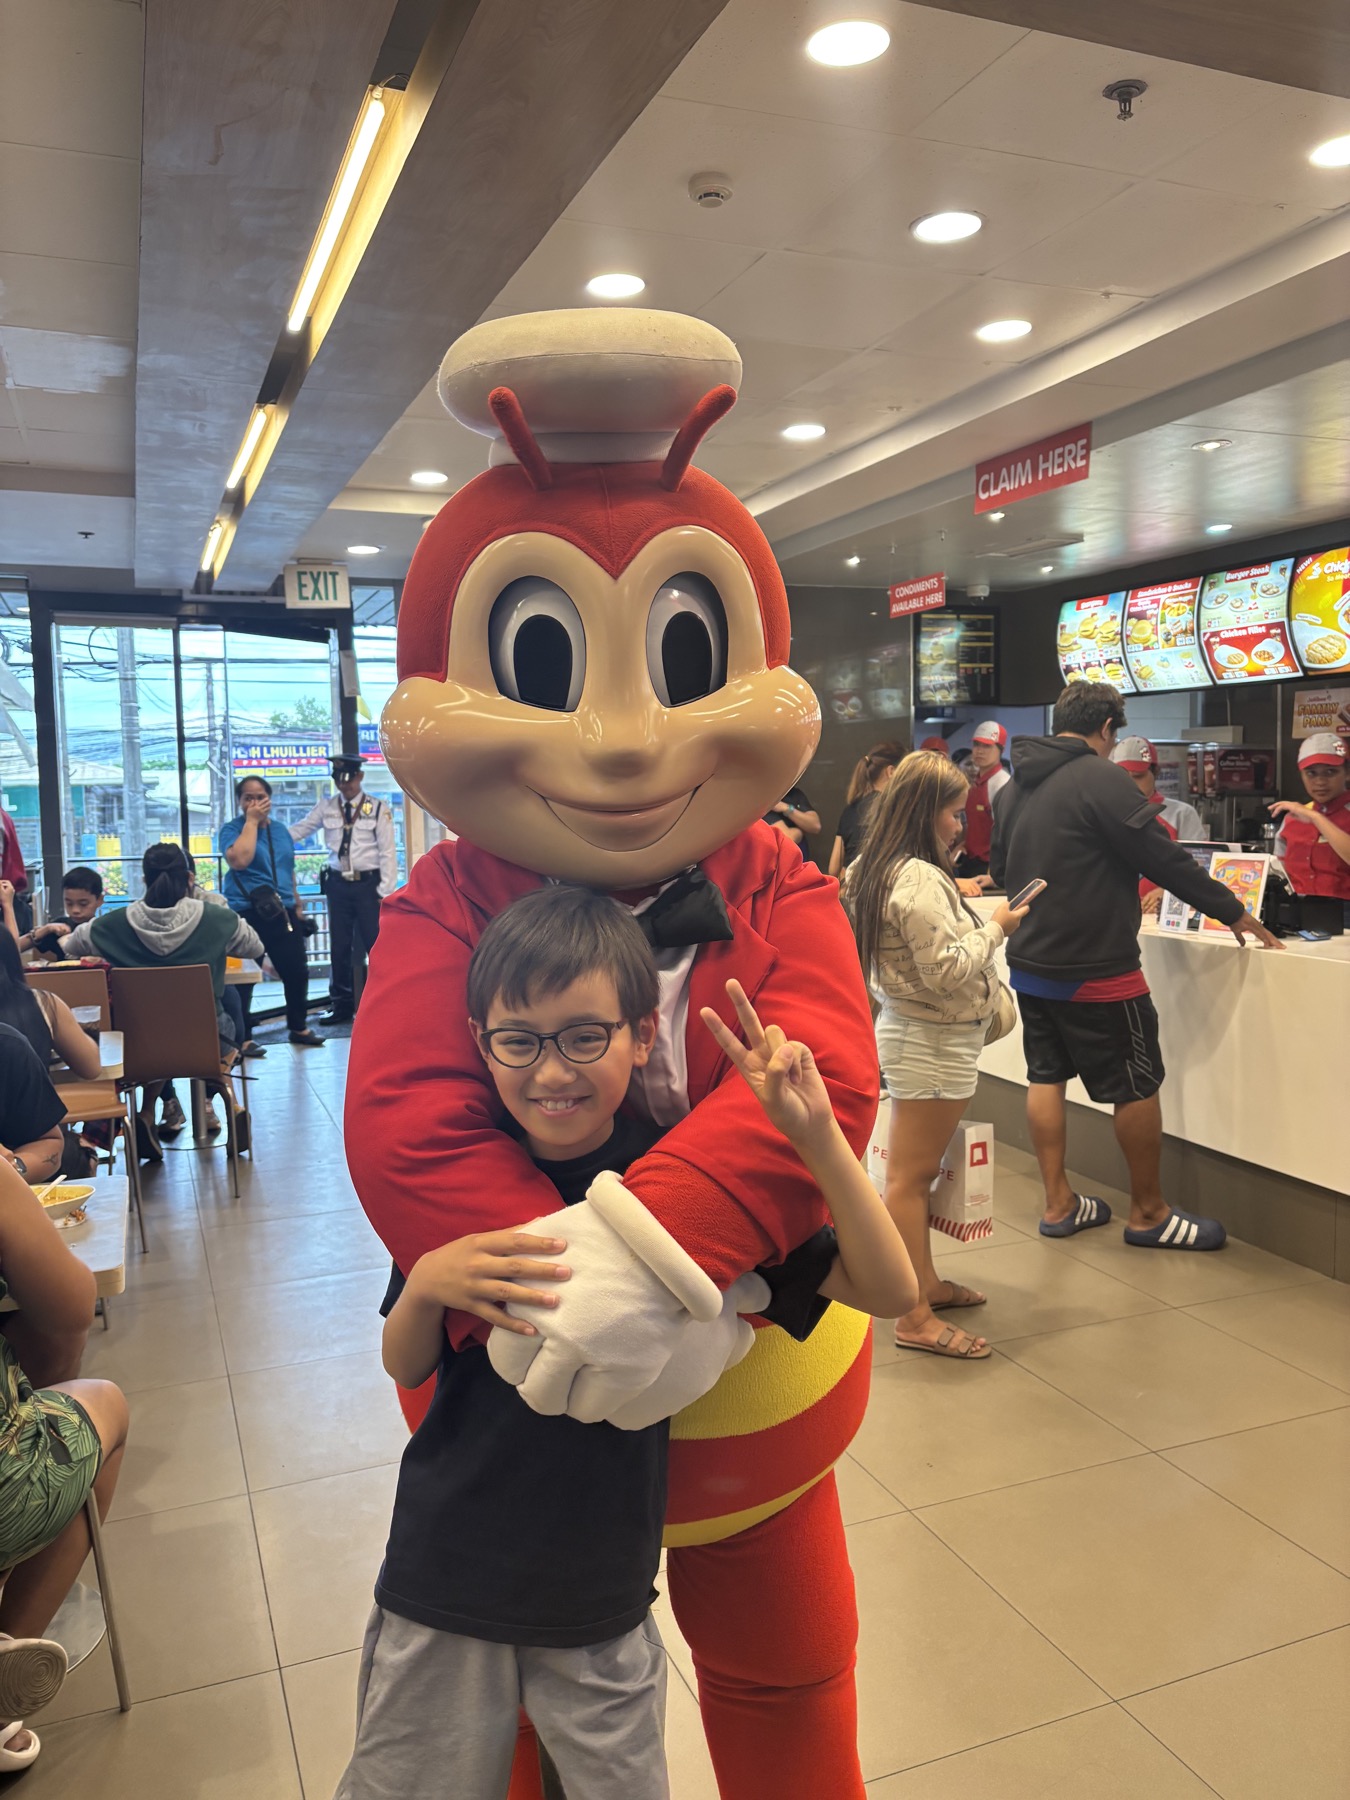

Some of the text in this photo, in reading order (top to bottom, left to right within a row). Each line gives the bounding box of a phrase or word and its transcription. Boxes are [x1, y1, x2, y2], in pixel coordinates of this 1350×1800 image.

[978, 438, 1087, 500] CLAIM HERE
[1226, 565, 1270, 581] Burger Steak
[1296, 556, 1313, 574] NEW!
[296, 570, 340, 601] EXIT
[895, 577, 939, 599] CONDIMENTS
[891, 591, 943, 614] AVAILABLE HERE
[1220, 628, 1247, 639] Chicken
[1248, 625, 1266, 636] Fillet
[1298, 702, 1339, 716] FAMILY
[1302, 714, 1332, 728] PANS
[263, 745, 327, 758] LHUILLIER
